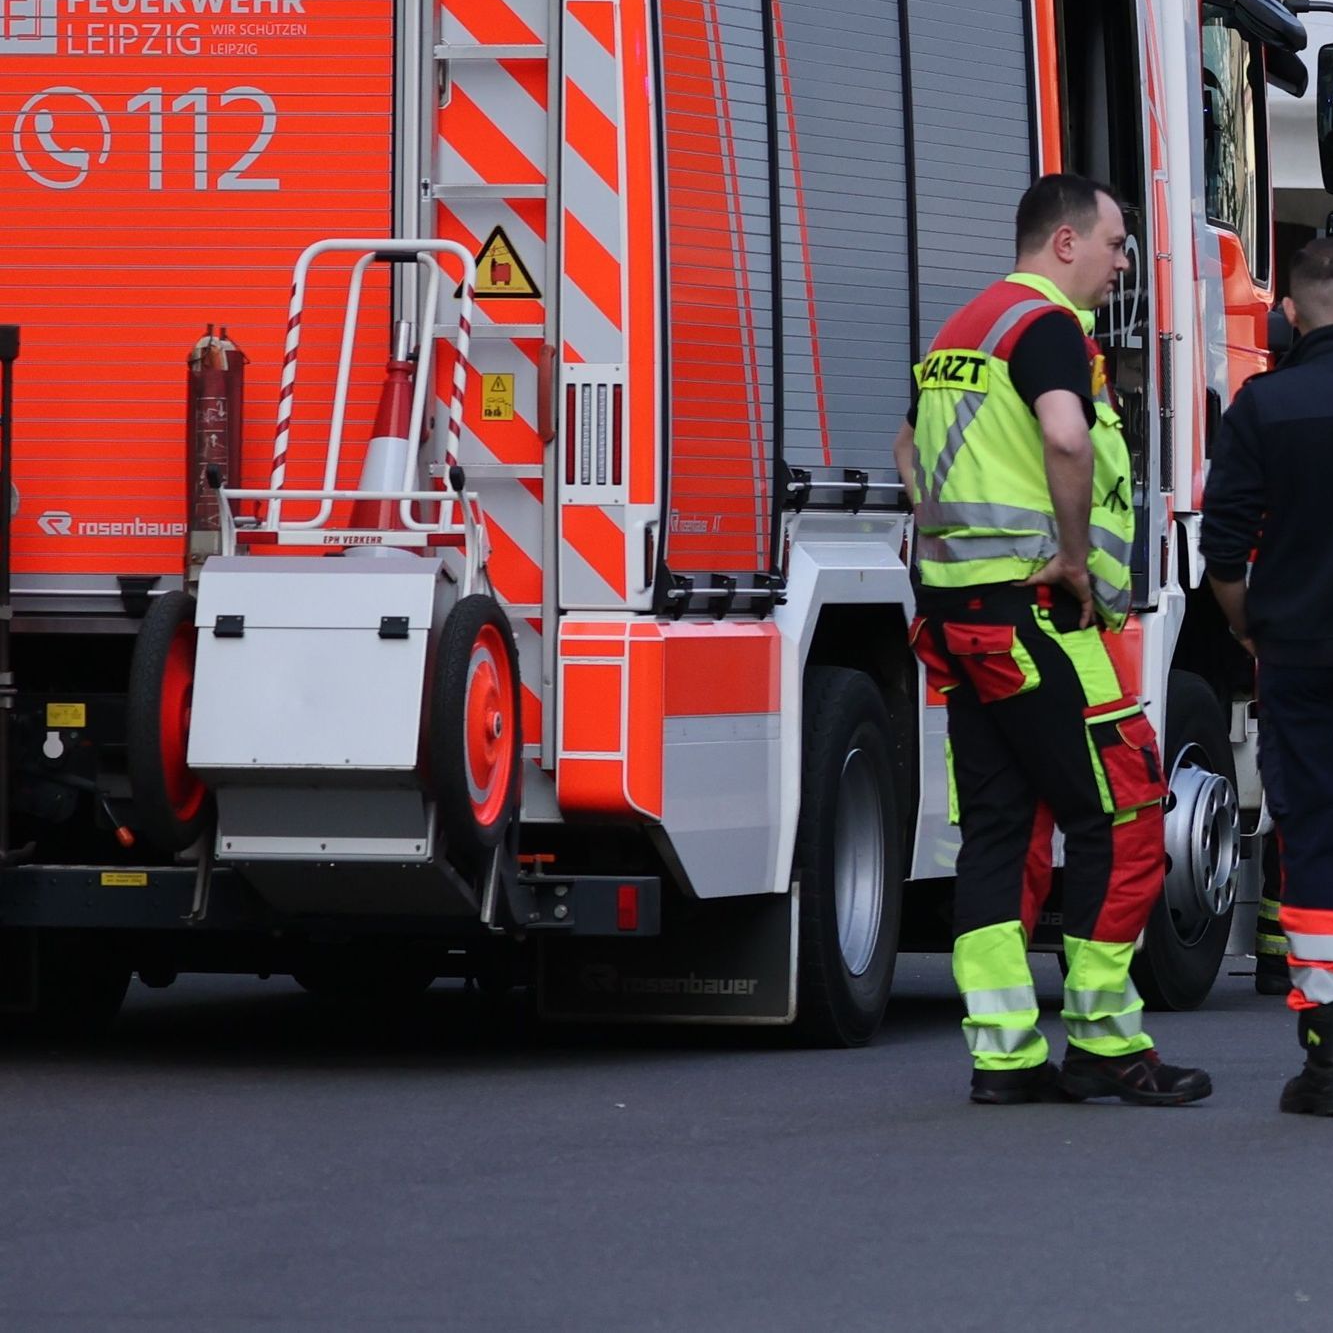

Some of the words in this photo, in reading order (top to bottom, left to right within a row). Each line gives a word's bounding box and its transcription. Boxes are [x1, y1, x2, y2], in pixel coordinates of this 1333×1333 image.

[210, 23, 236, 36] WIR
[239, 20, 308, 37] SCHÜTZEN
[67, 22, 201, 56] LEIPZIG
[209, 43, 258, 56] LEIPZIG
[126, 85, 281, 191] 112
[323, 535, 340, 544] EPH
[343, 535, 383, 544] VERKEHR
